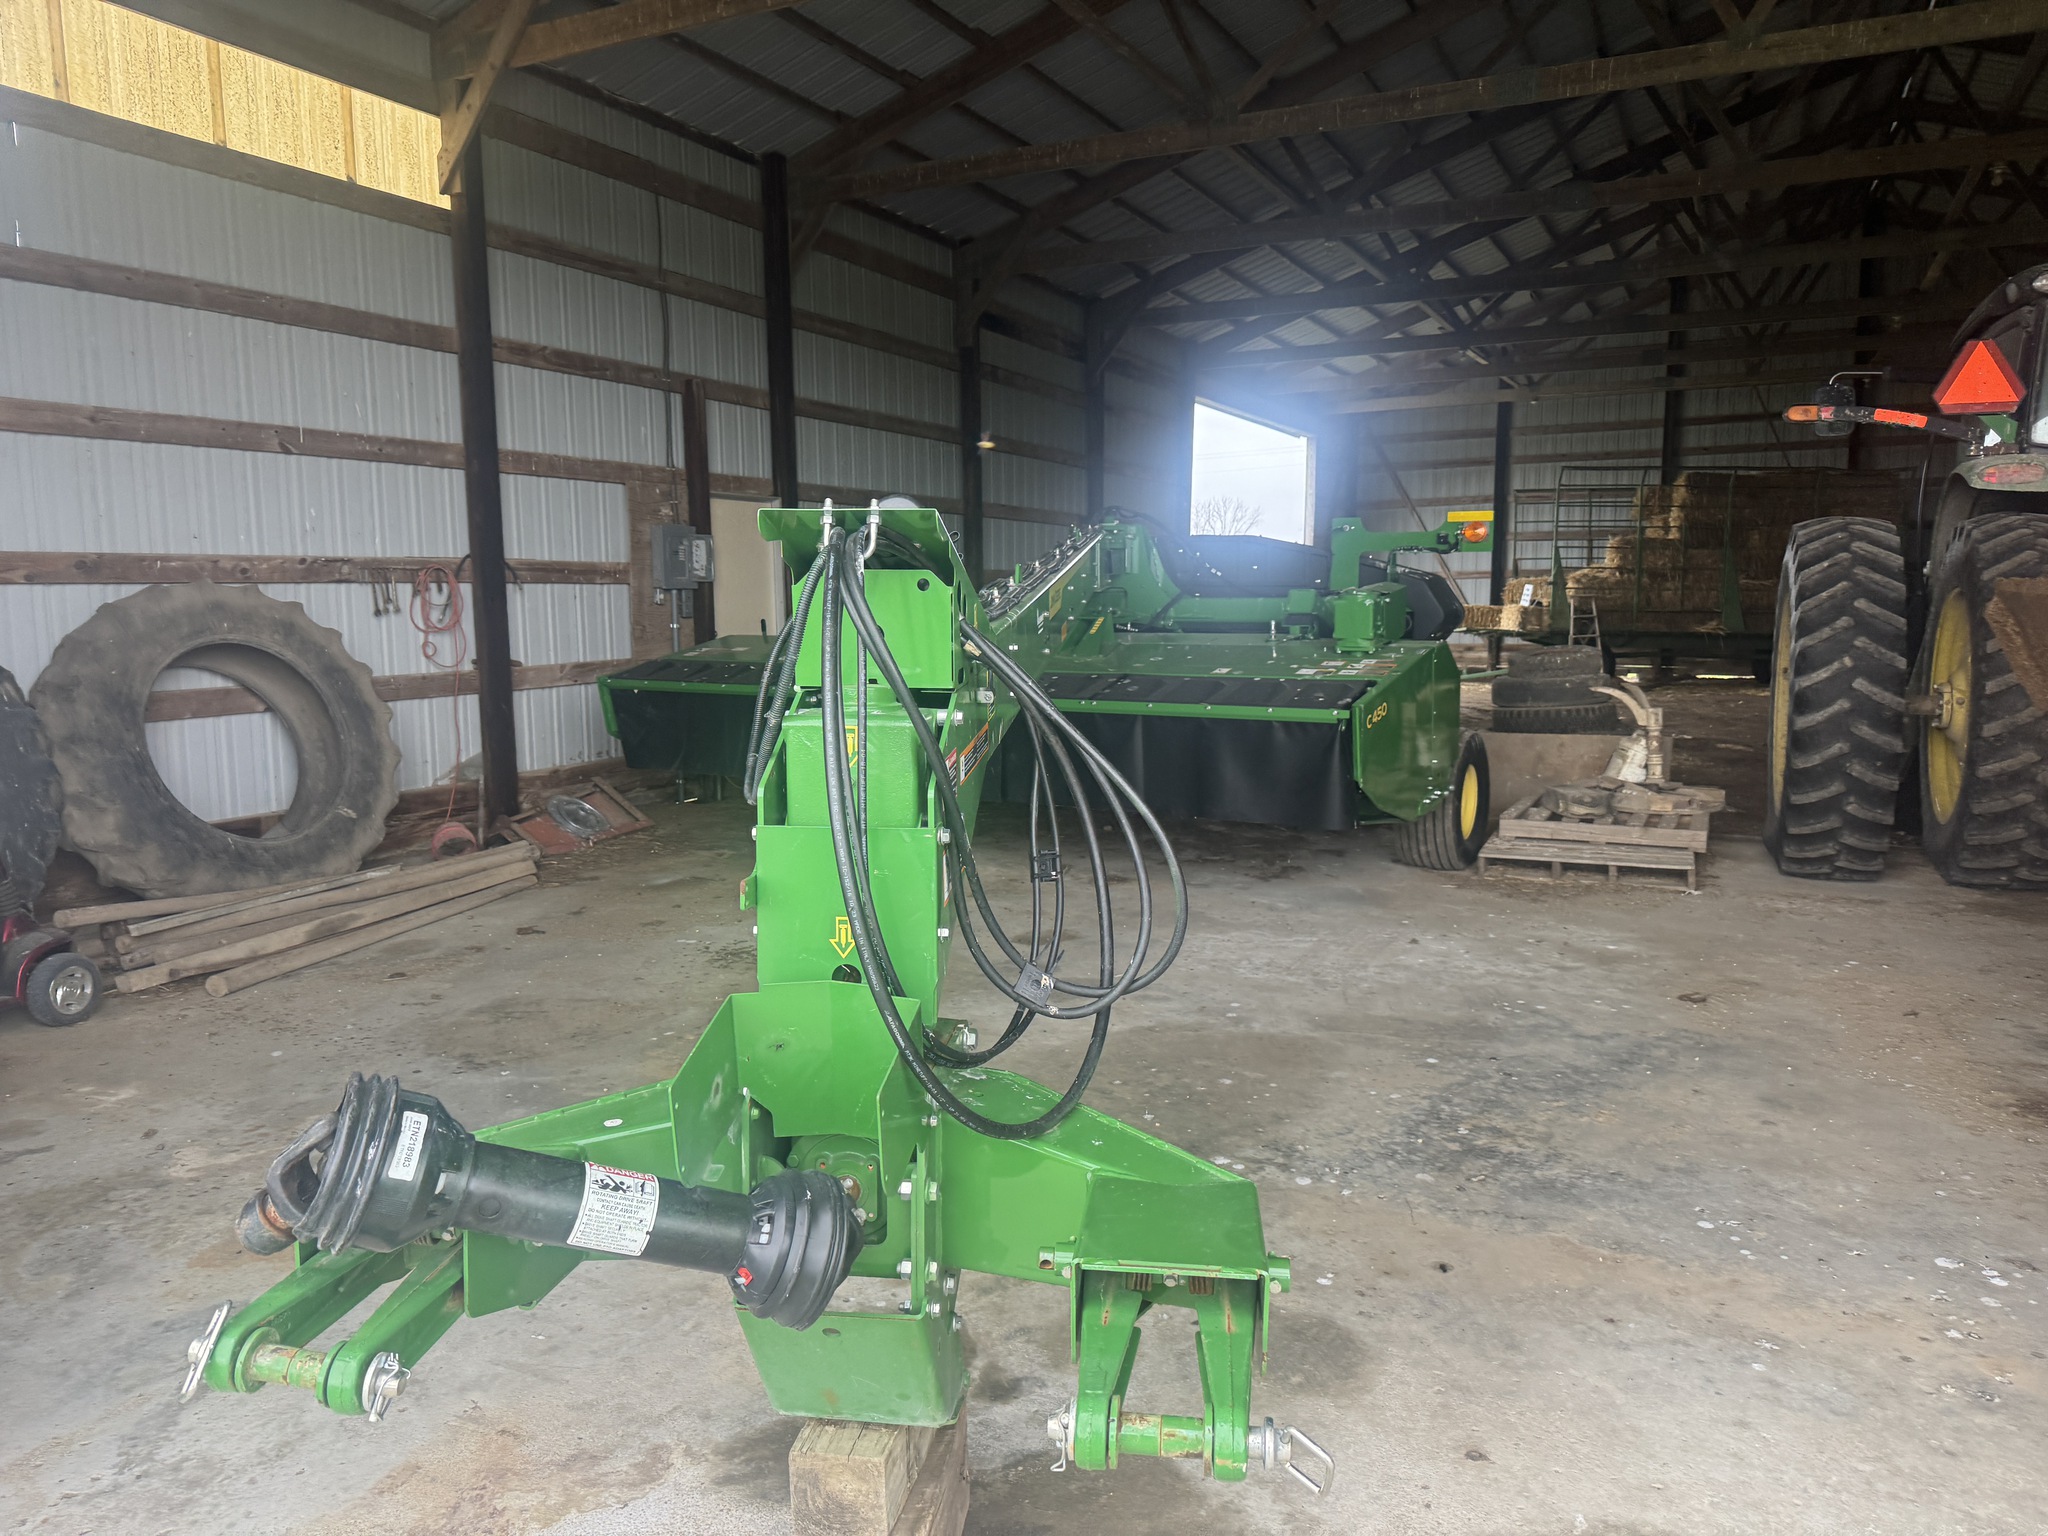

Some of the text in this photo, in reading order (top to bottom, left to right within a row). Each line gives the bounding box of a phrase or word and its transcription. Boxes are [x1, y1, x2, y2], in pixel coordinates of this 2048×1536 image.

[1367, 702, 1387, 728] C450
[402, 1120, 421, 1168] ETN218983
[607, 1167, 654, 1181] DANGER
[592, 1190, 652, 1207] ROTATING DRIVE SHAFT
[600, 1203, 639, 1216] KEEP AWAY!
